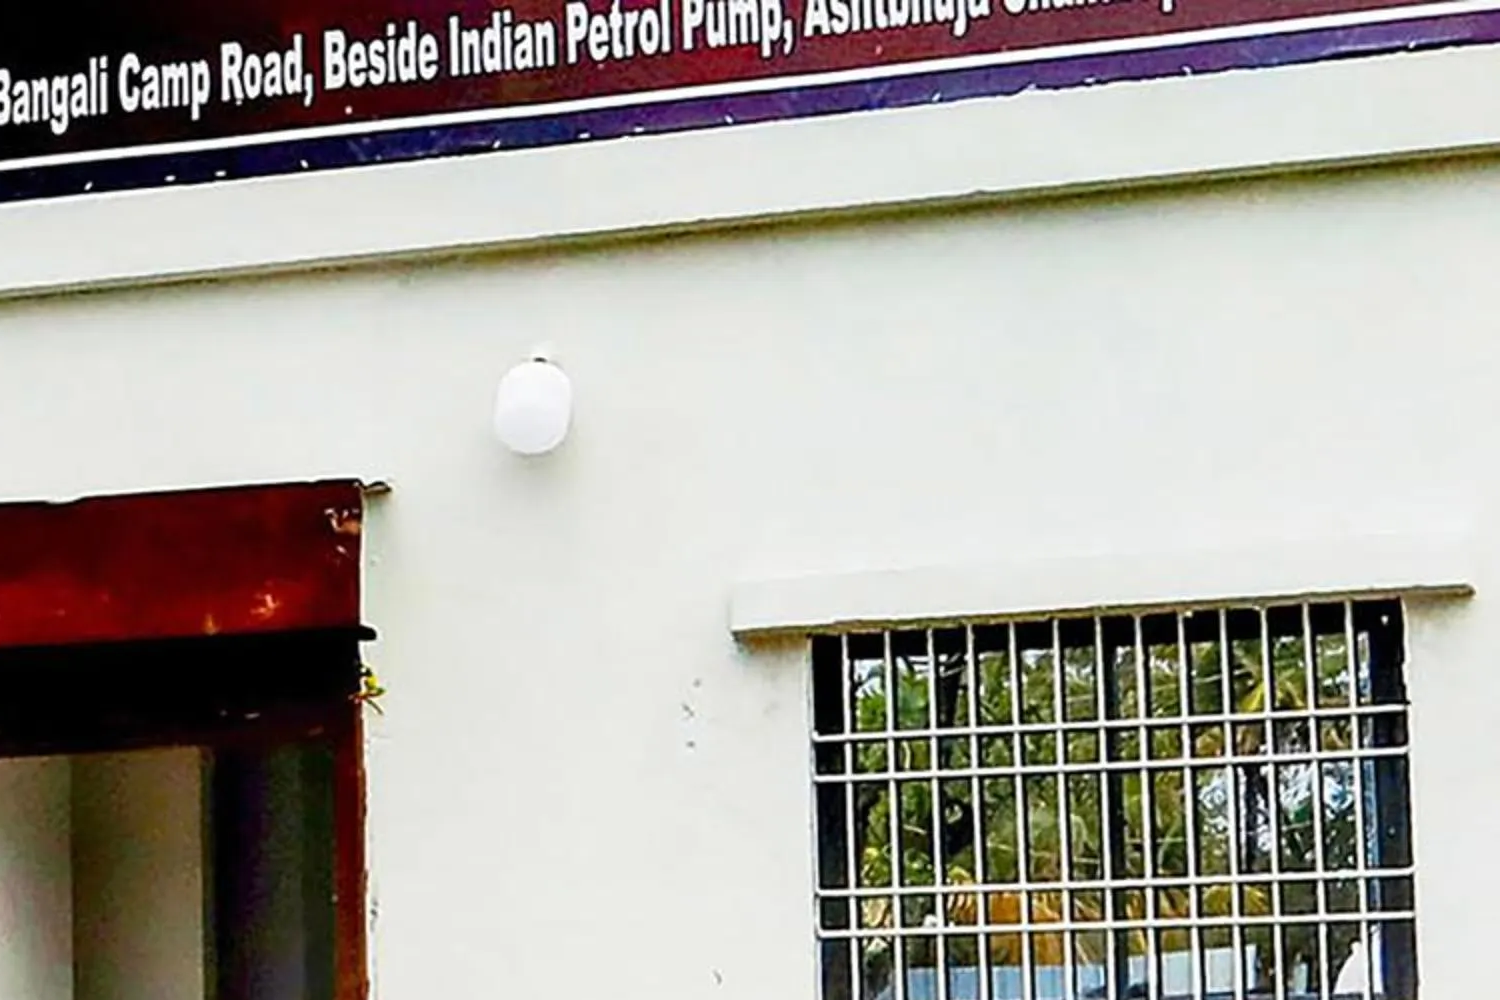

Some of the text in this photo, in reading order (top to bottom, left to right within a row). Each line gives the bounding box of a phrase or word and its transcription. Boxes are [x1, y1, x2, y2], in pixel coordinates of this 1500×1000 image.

[118, 52, 211, 121] Camp
[221, 33, 314, 107] Road,
[324, 20, 439, 90] Beside
[449, 10, 555, 77] Indian
[566, 0, 671, 64] Petrol
[682, 0, 794, 58] Pump,
